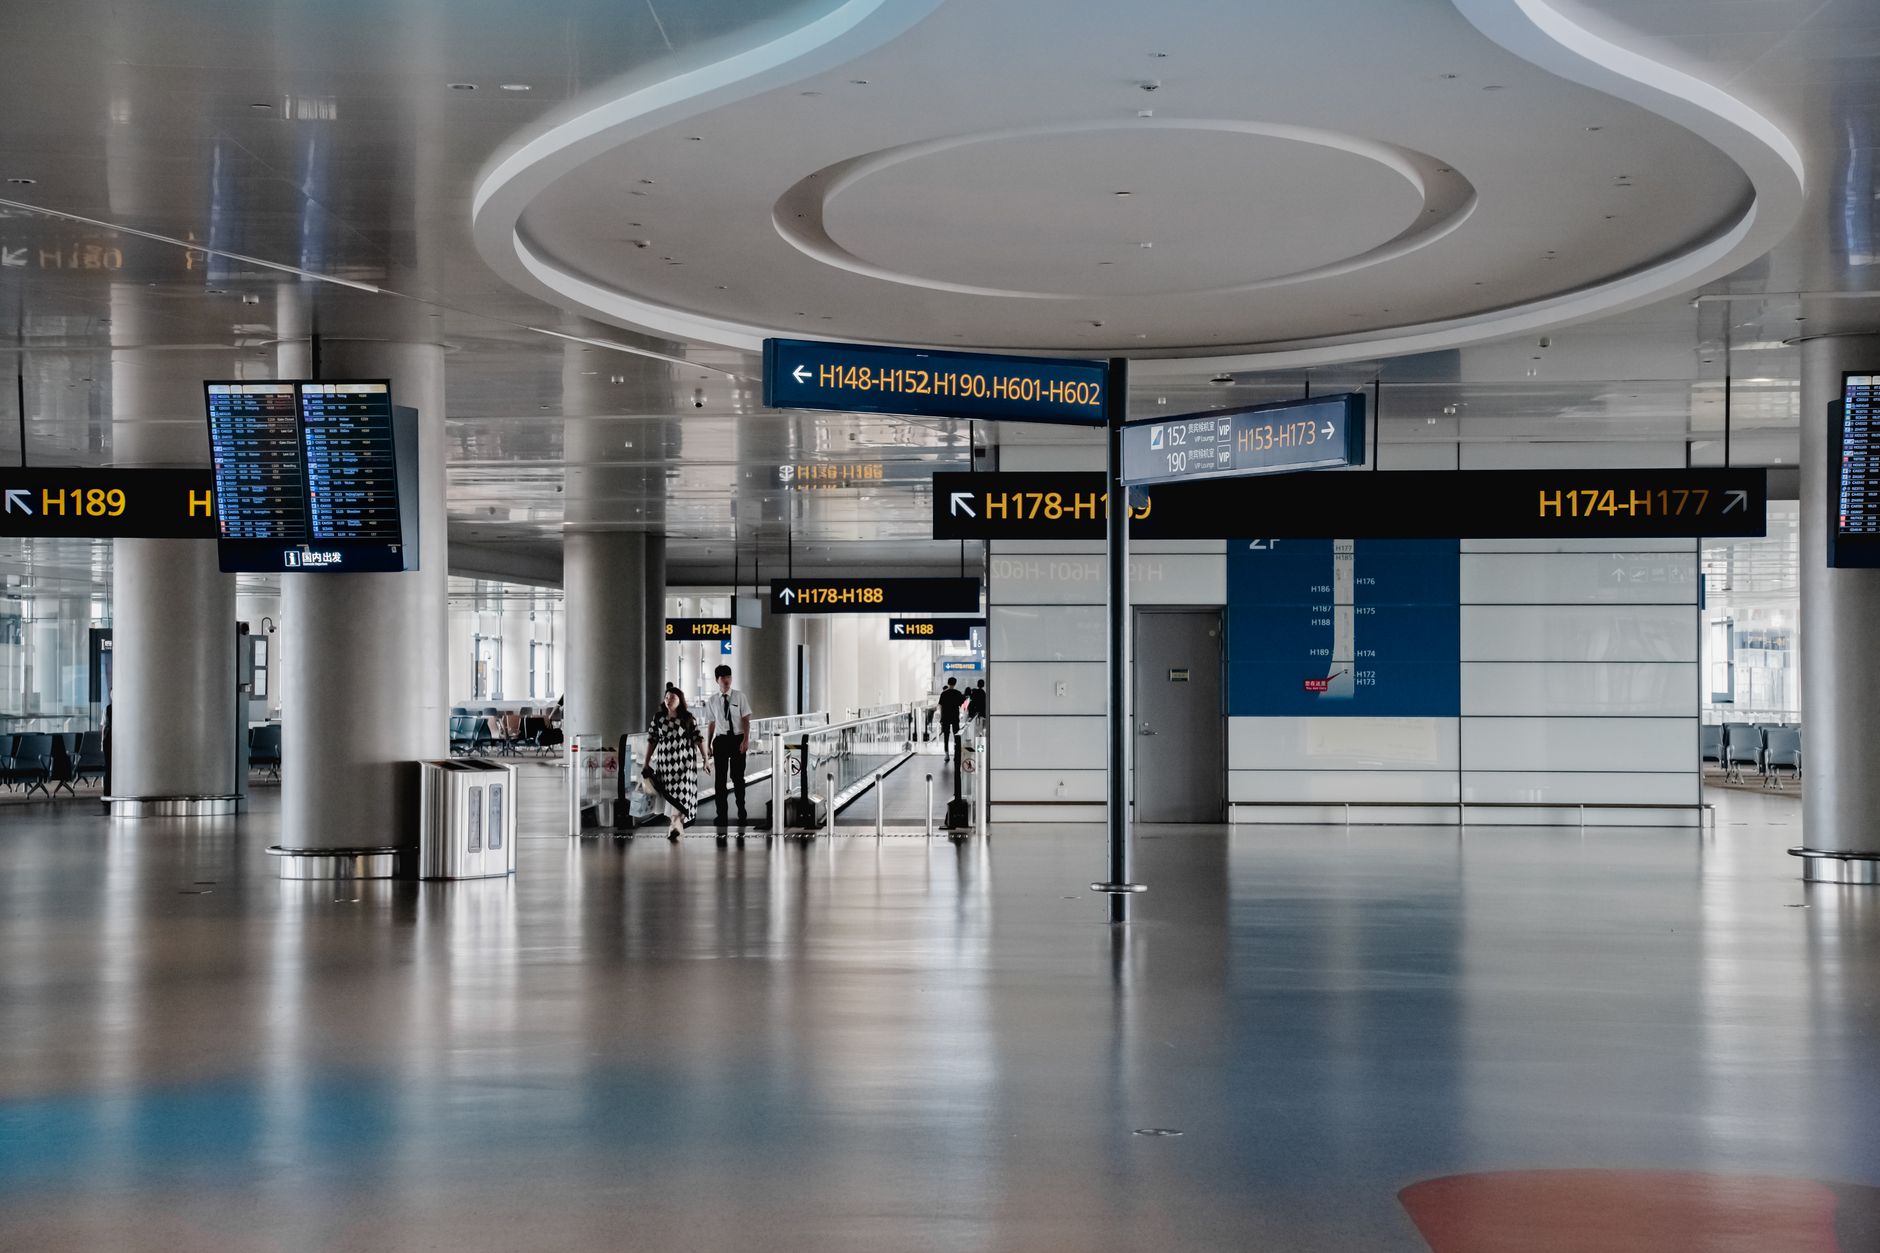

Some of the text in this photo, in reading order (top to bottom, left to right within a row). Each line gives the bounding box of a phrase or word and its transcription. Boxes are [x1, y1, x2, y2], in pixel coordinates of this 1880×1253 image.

[1167, 424, 1186, 447] 152
[1219, 424, 1230, 436] VIP
[1238, 420, 1316, 452] H153-H173
[1166, 451, 1187, 473] 190
[1218, 451, 1230, 463] VIP
[42, 488, 126, 517] H189
[1539, 489, 1710, 517] H174-H177
[302, 551, 342, 563] 国内出发
[1356, 577, 1376, 585] H176
[1311, 585, 1331, 593] H186
[797, 587, 884, 604] H178-H188
[1356, 607, 1376, 615] H175
[905, 623, 934, 635] H188
